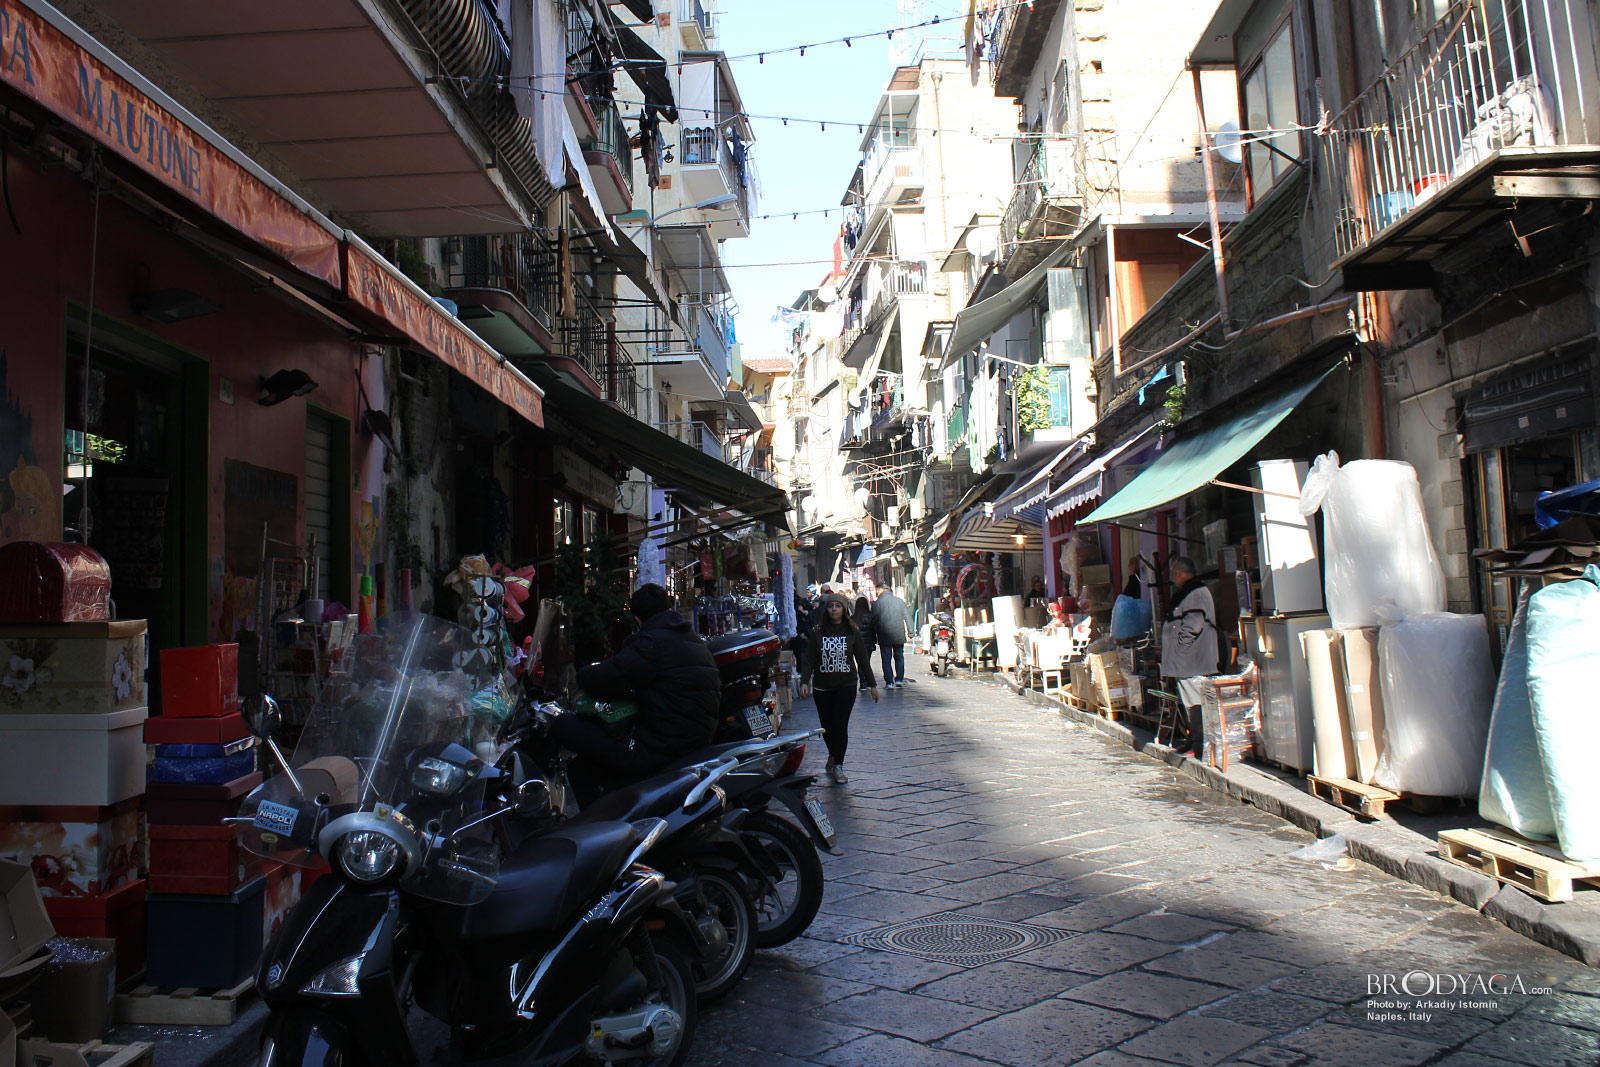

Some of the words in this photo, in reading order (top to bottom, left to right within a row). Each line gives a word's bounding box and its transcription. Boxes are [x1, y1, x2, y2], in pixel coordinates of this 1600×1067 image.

[75, 63, 201, 195] MAUTONE
[822, 657, 830, 665] BY
[832, 657, 847, 665] HER
[819, 664, 851, 673] CLOTHES
[259, 810, 293, 825] NAPOLI
